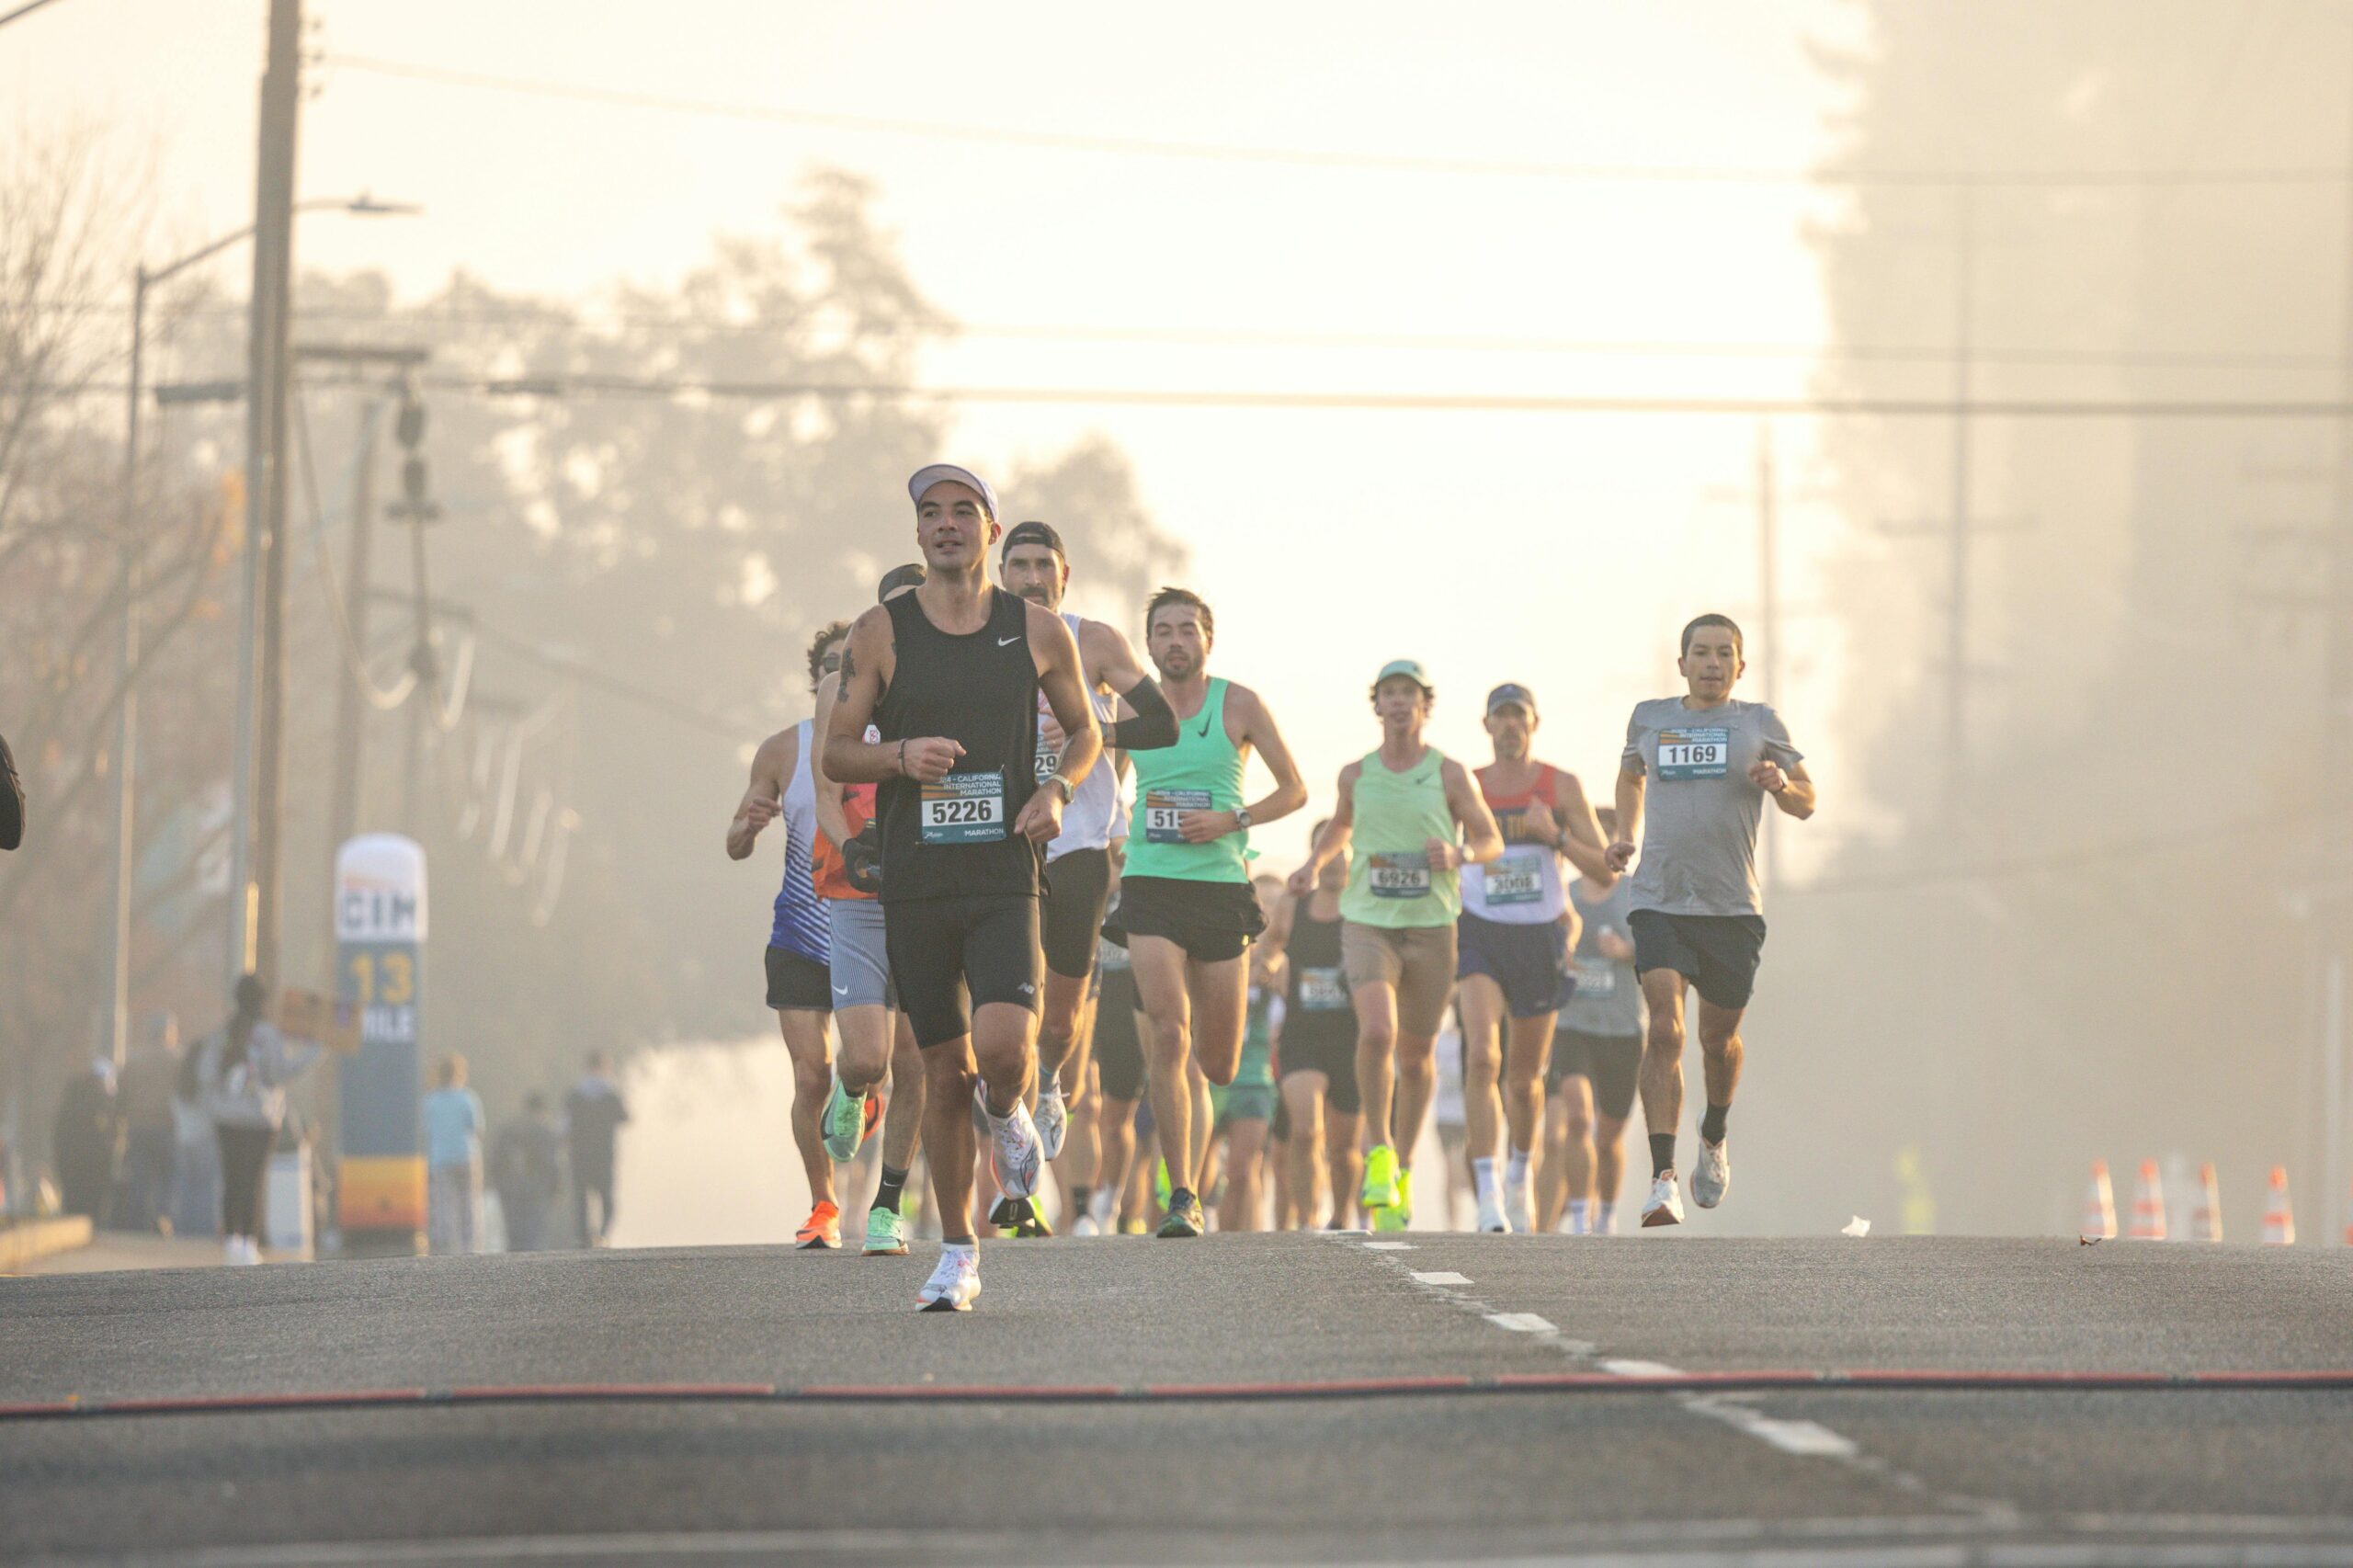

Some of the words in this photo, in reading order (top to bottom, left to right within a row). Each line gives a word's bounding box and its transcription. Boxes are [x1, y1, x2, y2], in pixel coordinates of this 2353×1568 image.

[1669, 745, 1716, 764] 1169
[1035, 755, 1057, 774] 29
[943, 780, 1001, 791] INTERNATIONAL
[958, 774, 1001, 782] CALIFORNIA
[932, 799, 993, 824] 5226
[964, 828, 1004, 837] MARATHON
[351, 953, 413, 1005] 13
